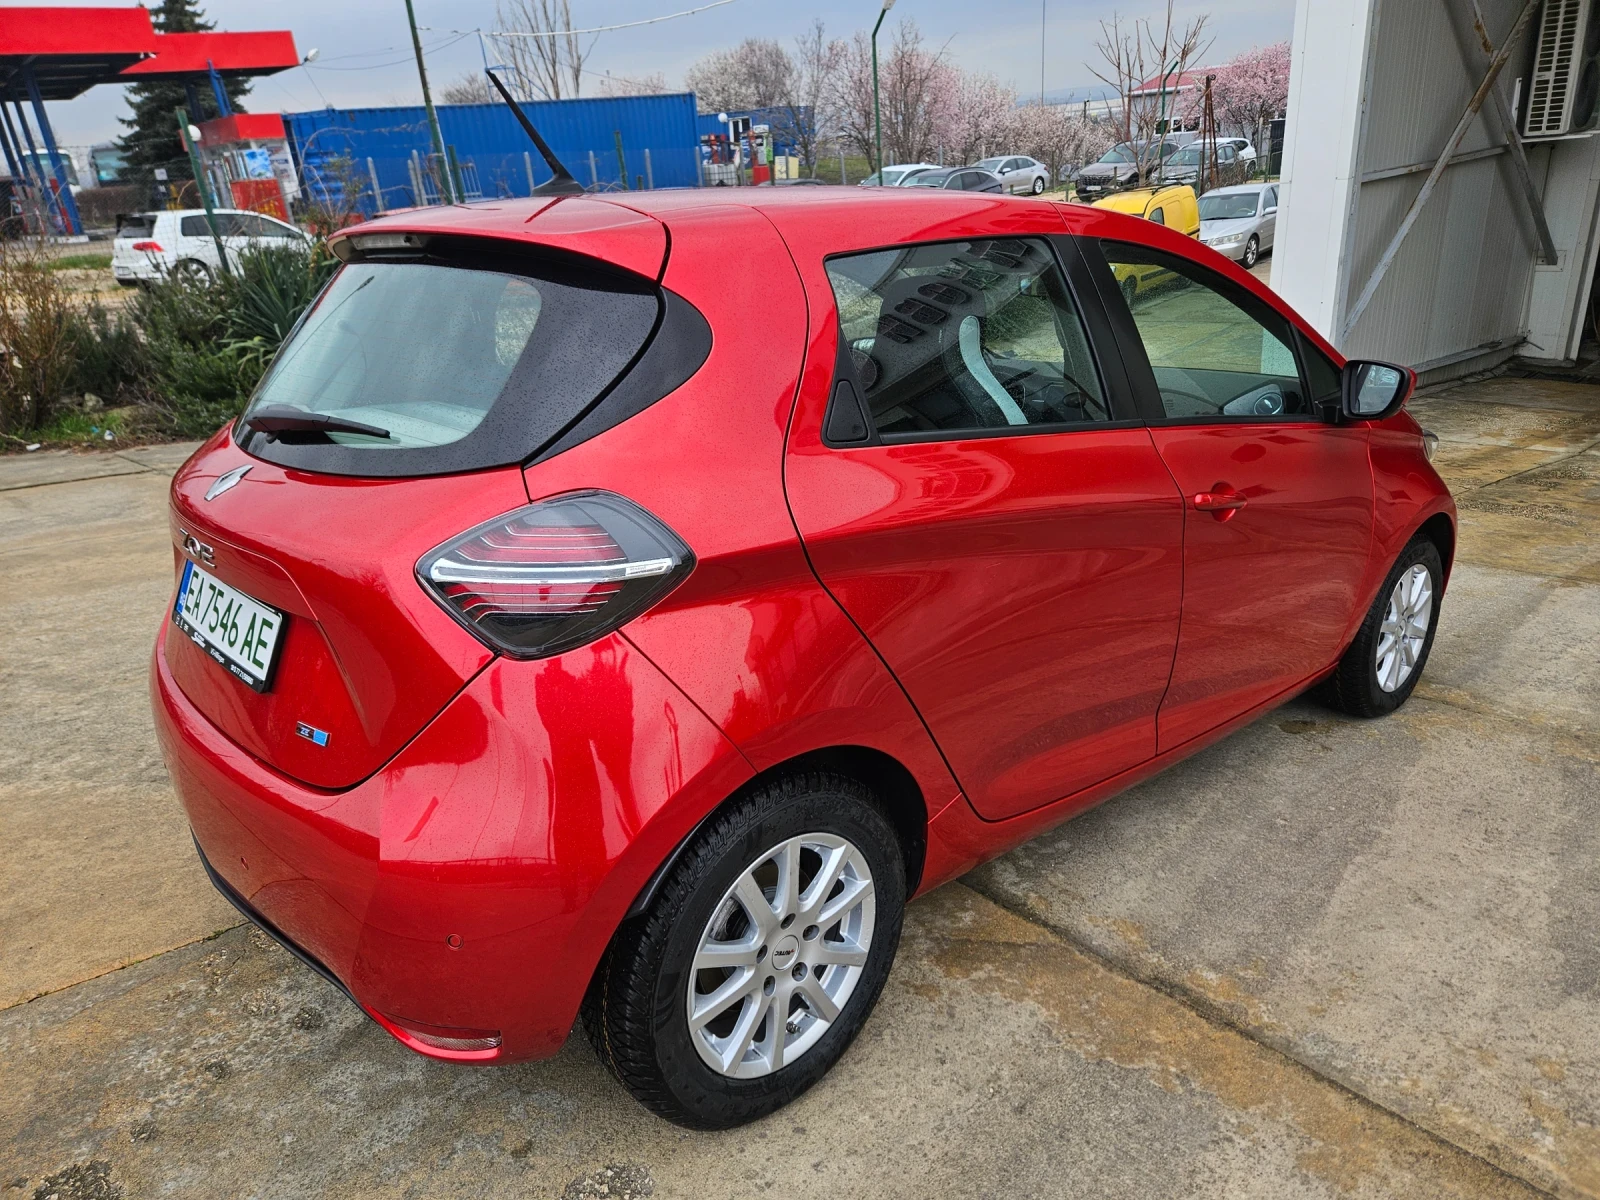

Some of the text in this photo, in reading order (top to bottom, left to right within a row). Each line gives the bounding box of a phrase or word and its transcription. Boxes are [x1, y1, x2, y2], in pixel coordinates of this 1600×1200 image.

[180, 528, 216, 568] ZOE
[184, 570, 274, 670] EA 7546 AE
